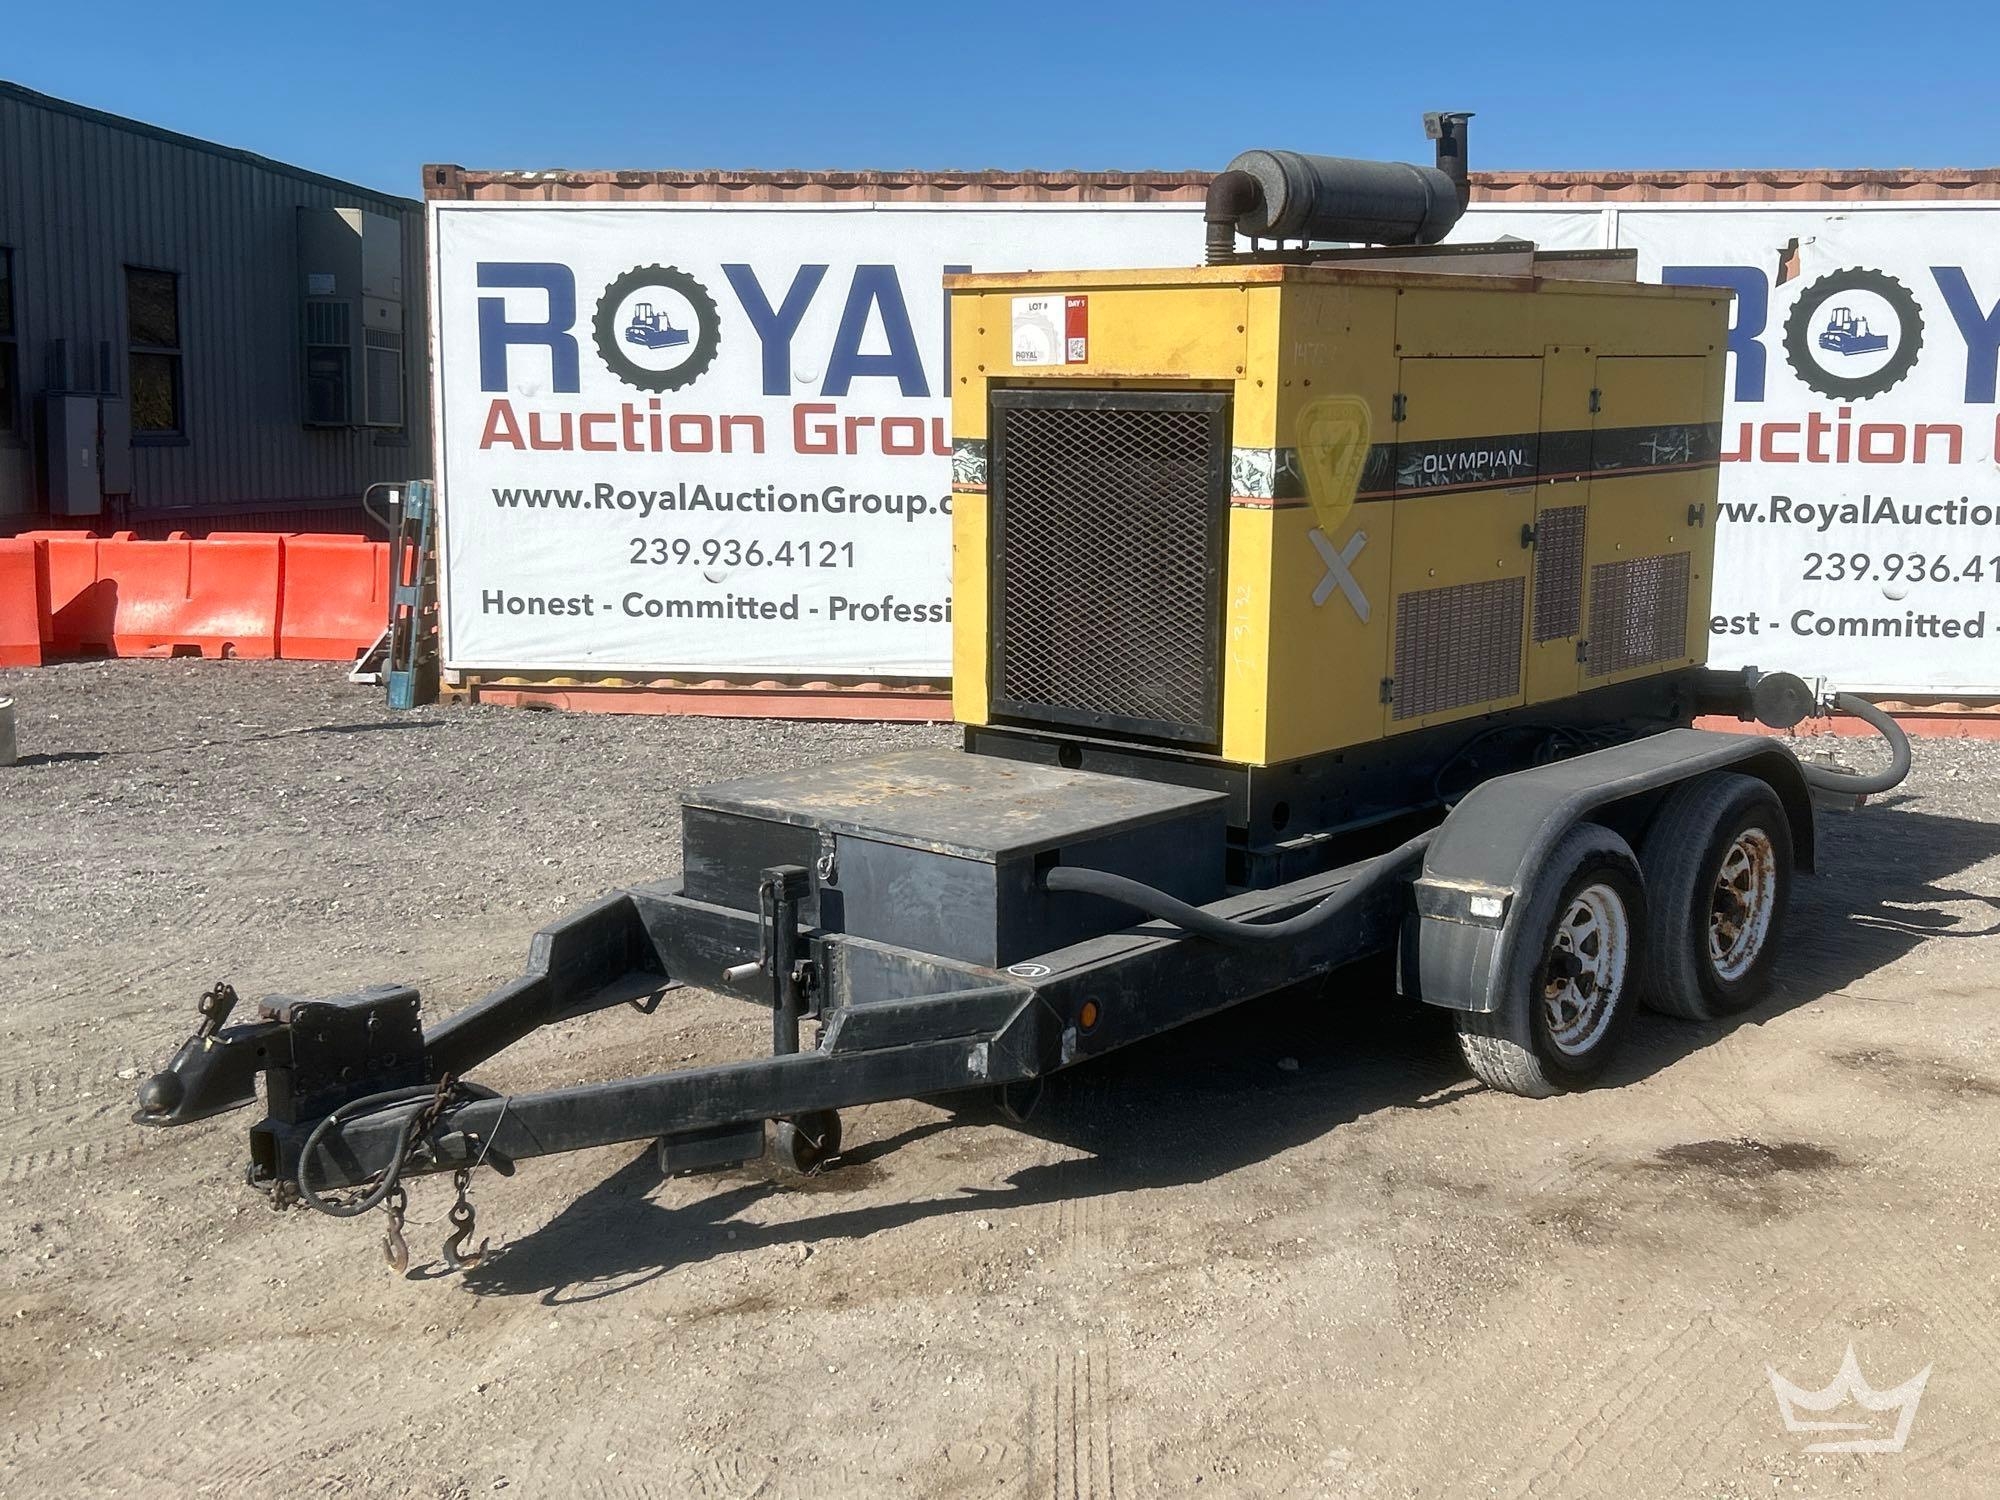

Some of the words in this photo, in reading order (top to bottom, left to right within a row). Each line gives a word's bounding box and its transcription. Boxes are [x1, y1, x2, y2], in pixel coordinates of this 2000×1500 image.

[1029, 303, 1042, 311] LOT
[1067, 300, 1080, 308] DAY
[479, 397, 765, 454] Auction
[1423, 449, 1522, 473] OLYMPIAN
[491, 483, 952, 522] www.RoyalAuctionGroup.c
[629, 537, 853, 568] 239.936.4121
[482, 589, 595, 617] Honest
[622, 591, 799, 620] Committed
[829, 594, 952, 623] Professi
[1709, 611, 1760, 635] est
[1790, 609, 1986, 639] Committed
